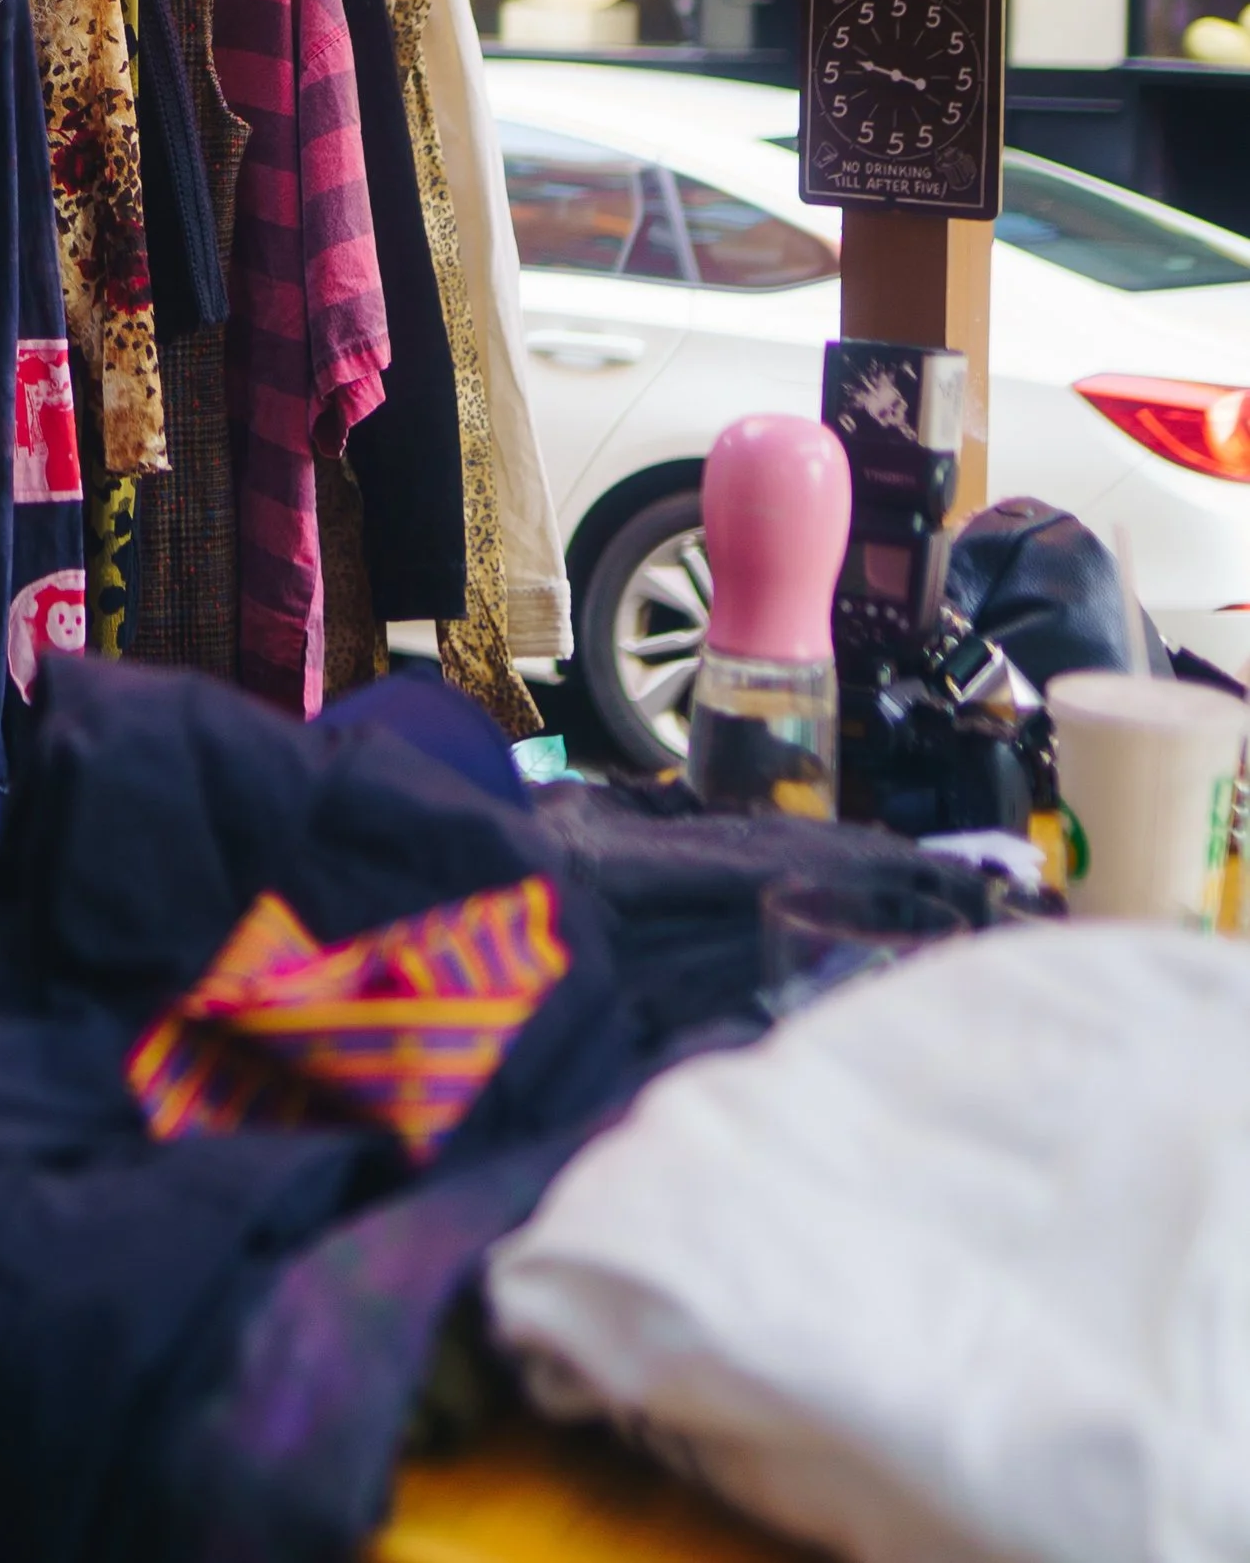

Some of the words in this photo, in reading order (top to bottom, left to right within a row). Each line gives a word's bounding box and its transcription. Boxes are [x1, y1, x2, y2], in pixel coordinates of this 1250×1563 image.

[858, 2, 875, 26] 5
[925, 5, 942, 29] 5
[832, 26, 850, 50] 5
[947, 31, 964, 56] 5
[823, 60, 841, 84] 5
[956, 67, 973, 92] 5
[832, 94, 849, 119] 5
[942, 101, 962, 126] 5
[858, 121, 875, 145] 5
[886, 132, 904, 156] 5
[916, 124, 934, 149] 5
[841, 160, 860, 174] NO
[865, 161, 932, 180] DRINKING
[866, 177, 911, 195] AFTER
